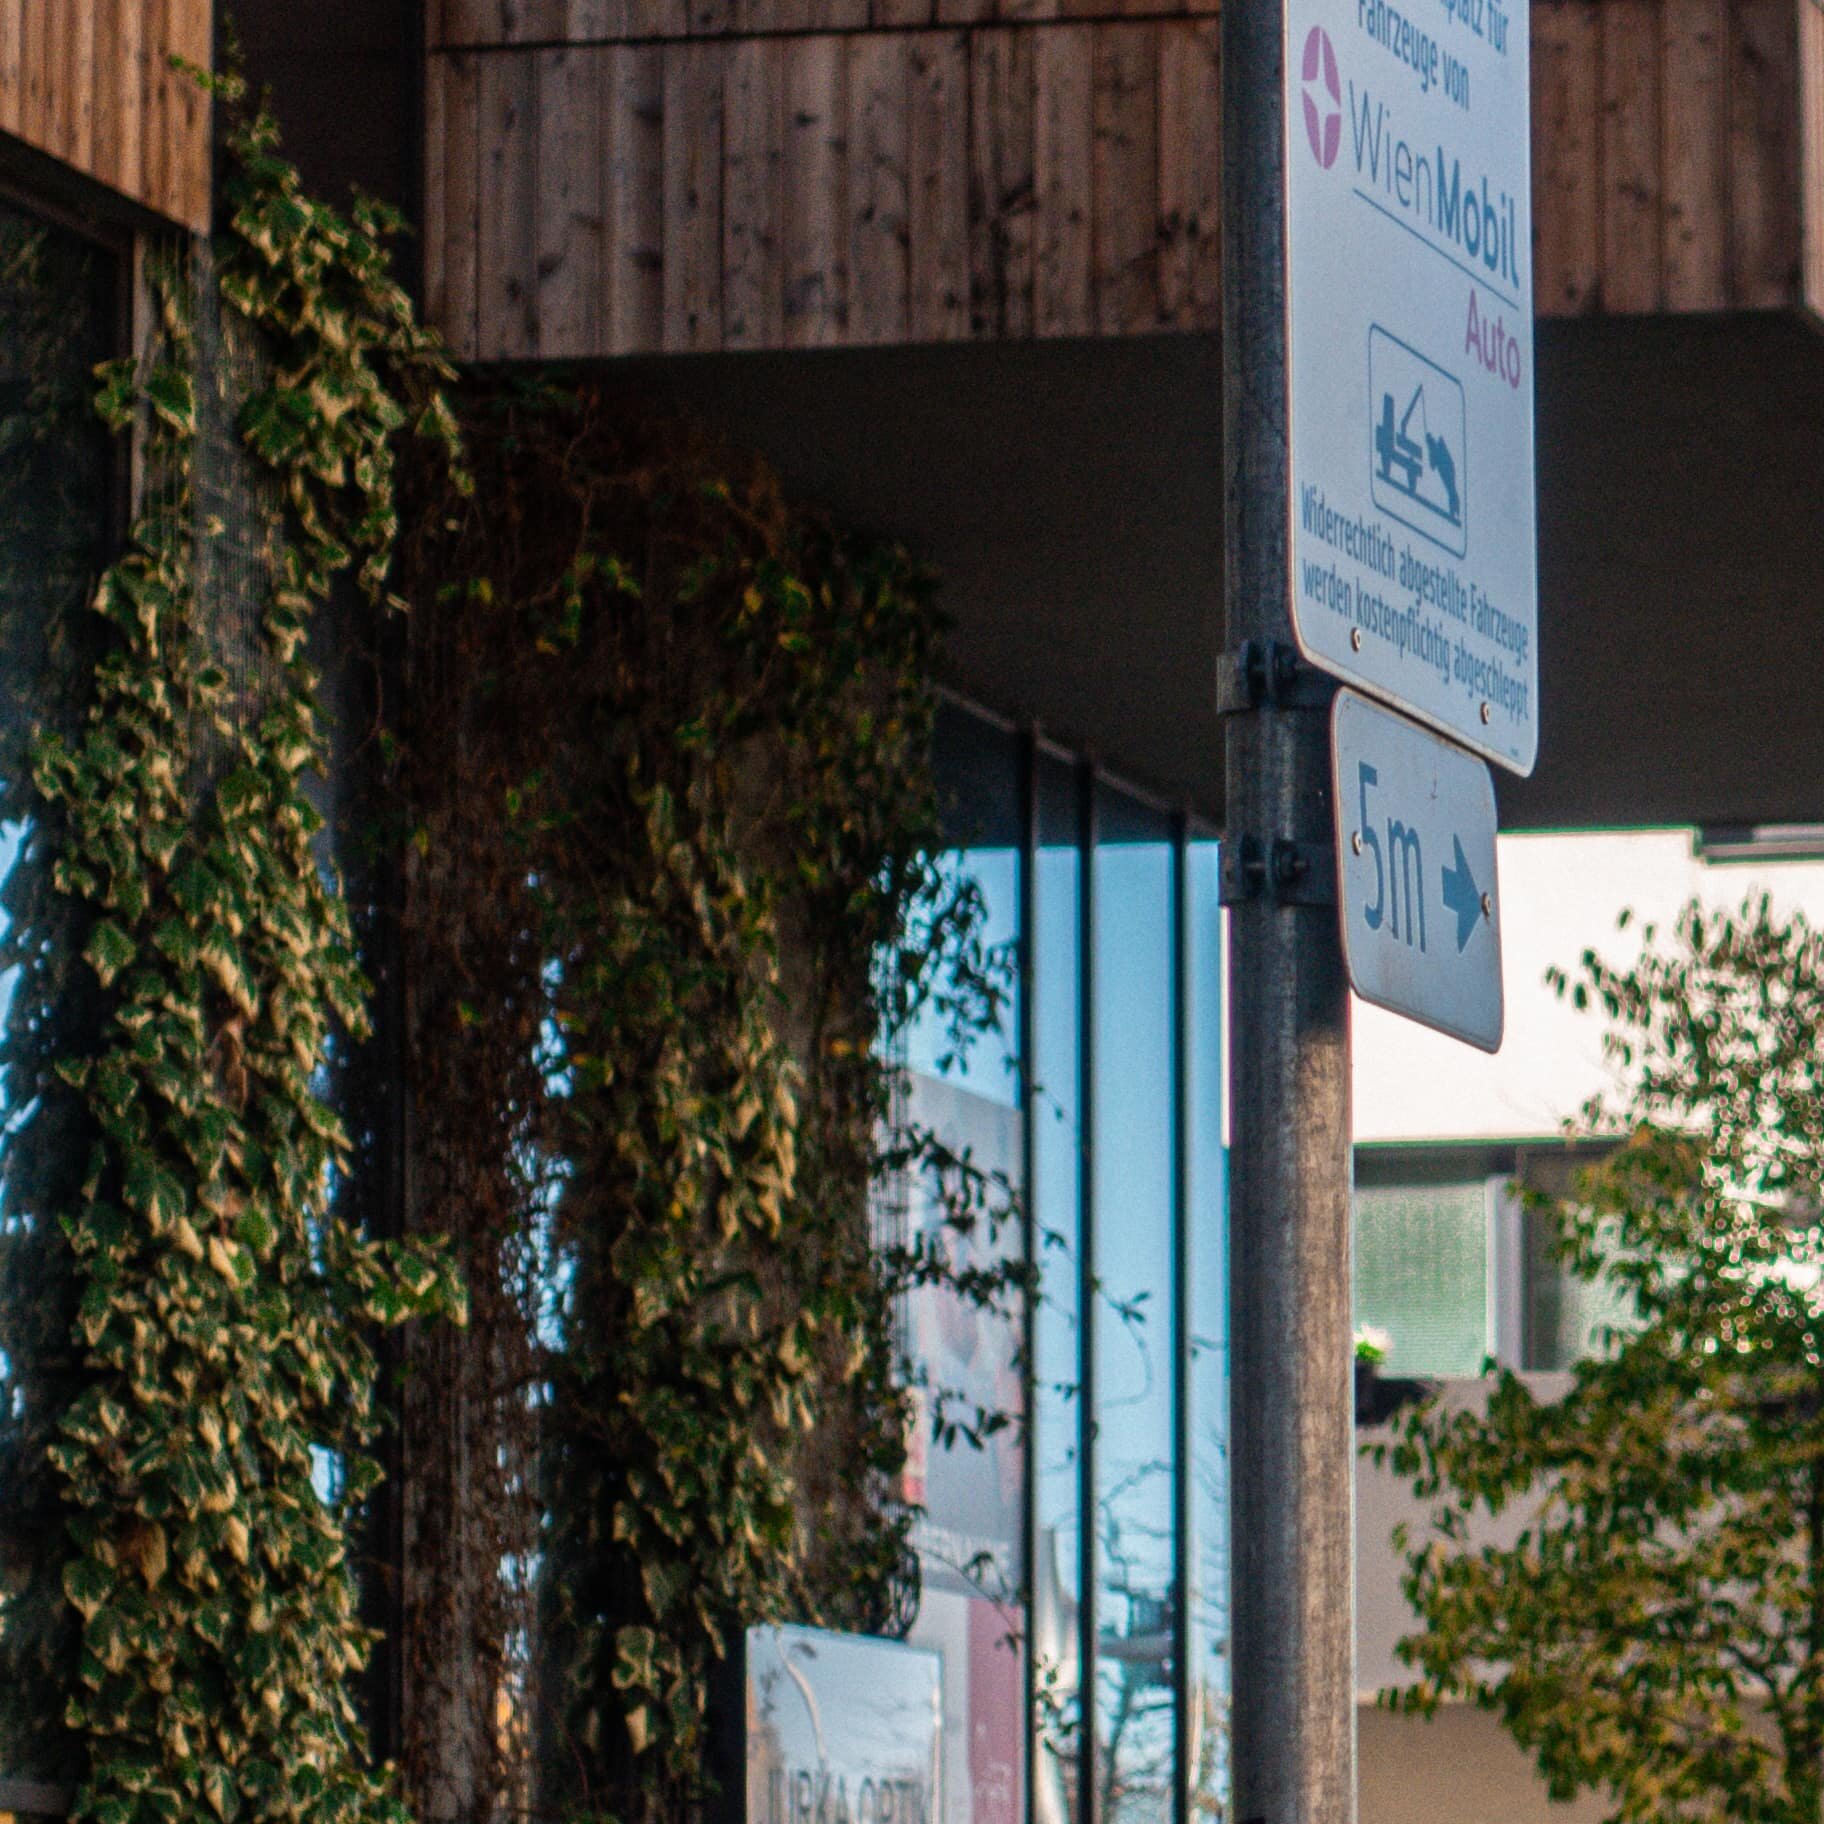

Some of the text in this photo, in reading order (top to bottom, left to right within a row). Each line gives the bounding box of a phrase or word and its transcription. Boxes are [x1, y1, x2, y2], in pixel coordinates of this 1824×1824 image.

[1442, 50, 1471, 112] von
[1349, 79, 1520, 289] WienMobil
[1464, 287, 1521, 390] Auto
[1301, 480, 1529, 666] Widerrechtlich abgestellte Fahrzeuge
[1303, 558, 1530, 726] werden kostenpflichtig abgeschleppt
